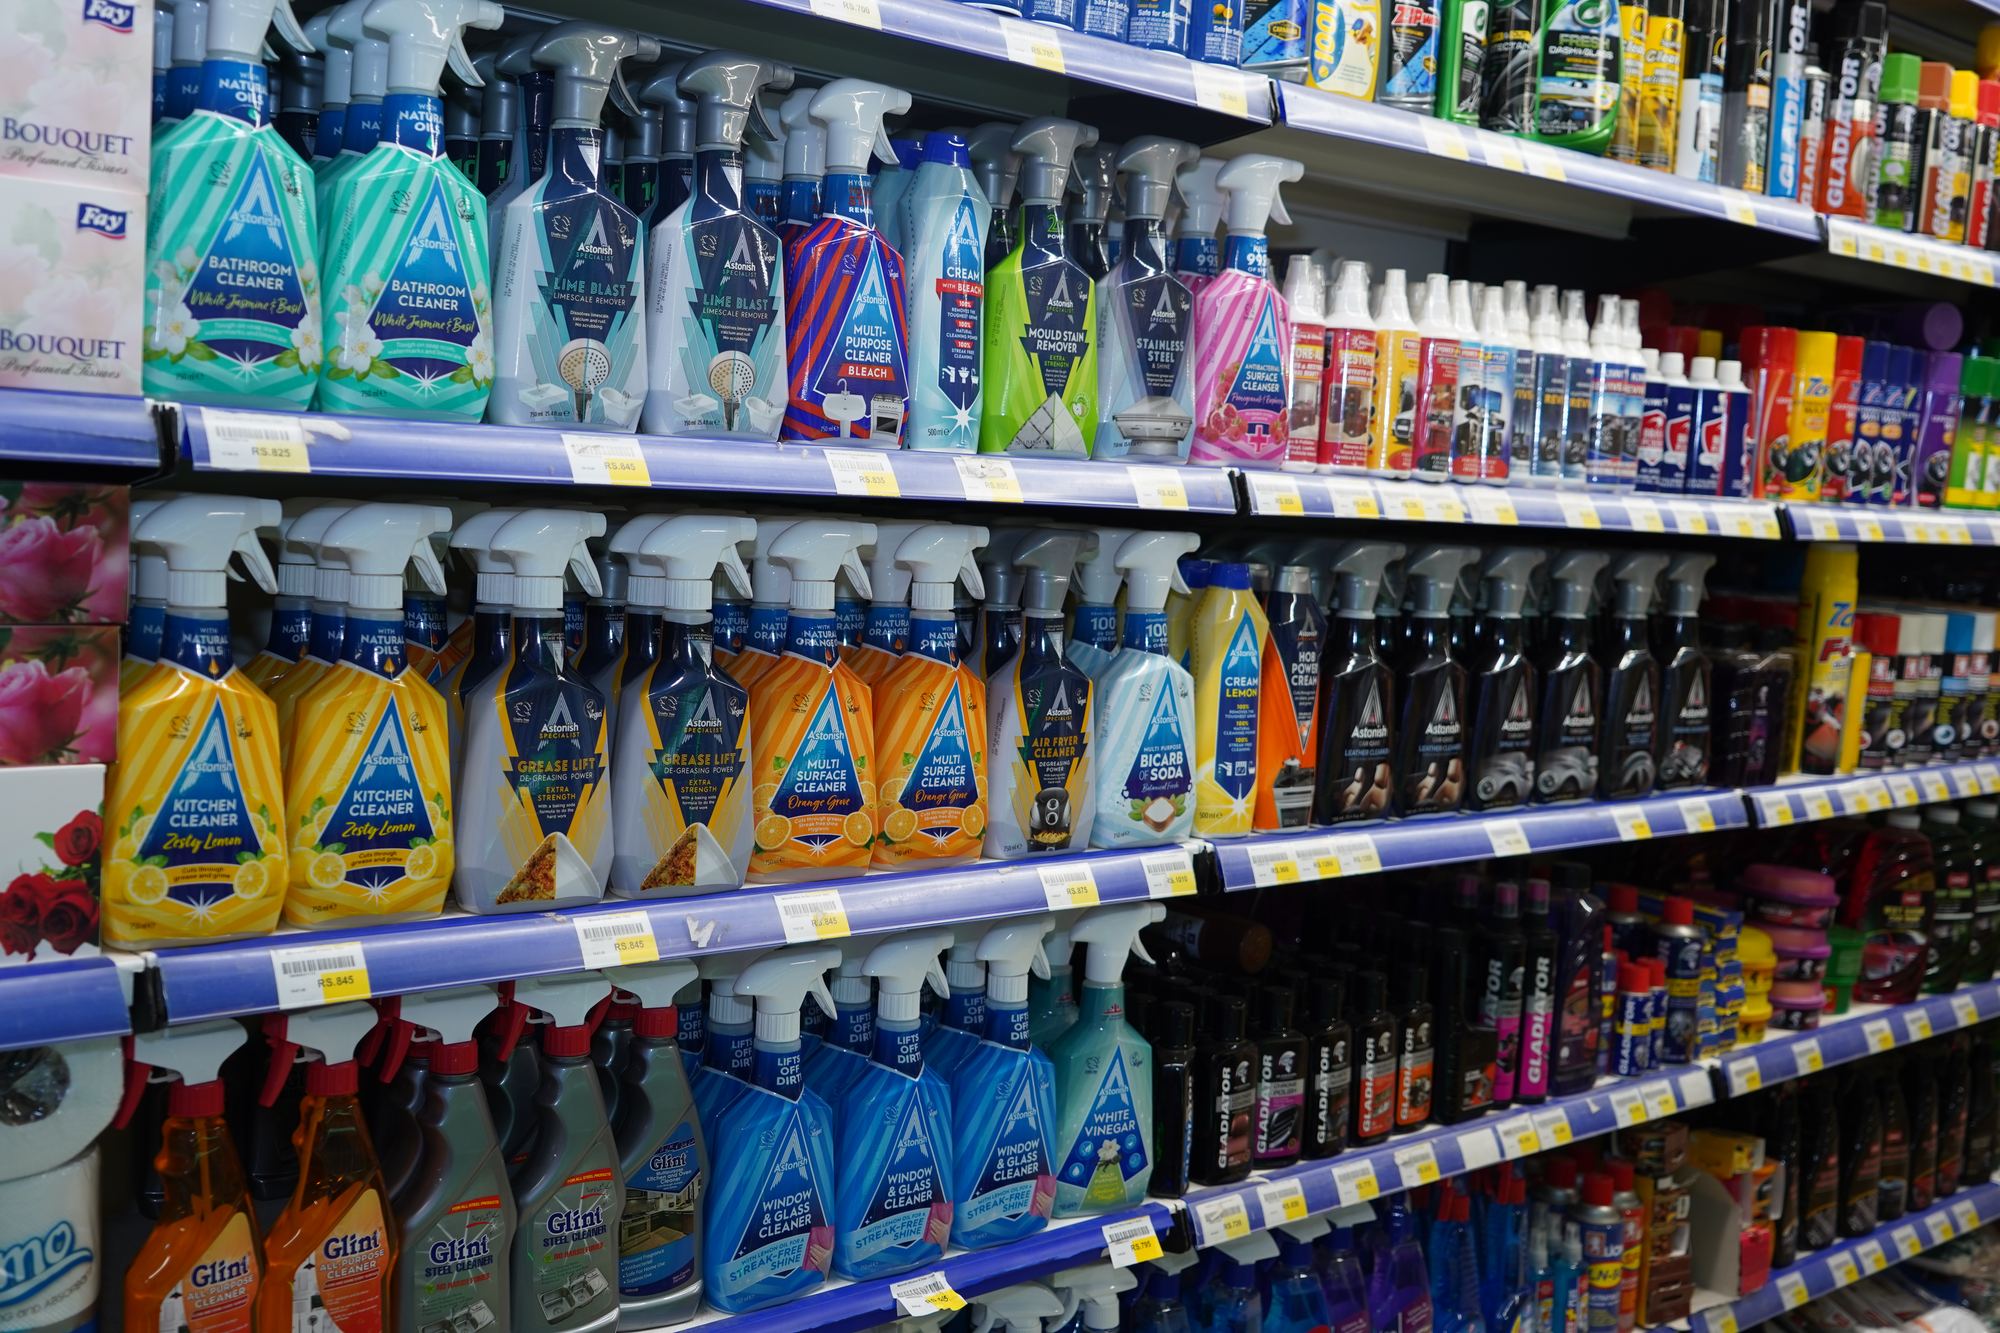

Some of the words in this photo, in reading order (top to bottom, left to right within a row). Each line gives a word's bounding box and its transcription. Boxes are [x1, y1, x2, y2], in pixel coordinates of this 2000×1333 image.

[1, 117, 133, 158] BOUQUET
[1826, 56, 1861, 208] GLADIATOR
[1, 146, 81, 170] Perfumed
[83, 156, 129, 175] Tissues
[410, 236, 456, 252] Astonish
[578, 242, 613, 255] Astonish
[209, 255, 292, 277] BATHROOM
[724, 260, 756, 272] Astonish
[947, 267, 979, 281] CREAM
[216, 272, 285, 291] CLEANER
[553, 277, 584, 294] LIME
[590, 282, 625, 297] BLAST
[392, 280, 466, 299] BATHROOM
[957, 283, 981, 295] BLEACH
[398, 296, 458, 311] CLEANER
[553, 292, 593, 303] LIMESCALE
[596, 297, 625, 306] REMOVER
[703, 294, 732, 308] LIME
[737, 298, 768, 310] BLAST
[857, 295, 887, 305] Astonish
[703, 307, 739, 317] LIMESCALE
[741, 311, 768, 320] REMOVER
[1029, 328, 1062, 341] MOULD
[1064, 330, 1084, 342] STAIN
[846, 336, 892, 351] PURPOSE
[1037, 340, 1077, 353] REMOVER
[1137, 338, 1184, 351] STAINLESS
[845, 350, 891, 363] CLEANER
[1148, 351, 1174, 363] STEEL
[1, 356, 71, 378] Perfumed
[72, 361, 121, 379] Tissues
[848, 365, 887, 378] BLEACH
[1246, 371, 1278, 382] SURFACE
[1242, 381, 1279, 393] CLEANSER
[251, 445, 291, 458] RS.825
[1299, 651, 1316, 662] HOB
[1225, 676, 1258, 686] CREAM
[1226, 688, 1257, 697] LEMON
[541, 723, 578, 733] Astonish
[686, 718, 722, 728] Astonish
[808, 730, 844, 741] Astonish
[934, 728, 964, 738] Astonish
[1352, 725, 1388, 738] Astonish
[1032, 738, 1050, 747] AIR
[1053, 736, 1078, 746] FRYER
[662, 753, 711, 766] GREASE
[714, 752, 736, 765] LIFT
[1034, 747, 1075, 758] CLEANER
[1140, 752, 1183, 767] BICARB
[186, 761, 234, 773] Astonish
[364, 754, 409, 766] Astonish
[518, 759, 568, 772] GREASE
[572, 758, 595, 771] LIFT
[807, 759, 839, 769] MULTI
[933, 755, 960, 765] MULTI
[796, 770, 846, 782] SURFACE
[923, 765, 966, 776] SURFACE
[1139, 769, 1150, 780] OF
[1151, 766, 1183, 780] SODA
[795, 781, 846, 793] CLEANER
[921, 776, 966, 788] CLEANER
[353, 789, 413, 802] KITCHEN
[537, 793, 576, 801] STRENGTH
[173, 799, 237, 812] KITCHEN
[349, 803, 414, 816] CLEANER
[169, 813, 238, 828] CLEANER
[342, 821, 378, 840] Zesty
[379, 820, 416, 836] Lemon
[162, 832, 201, 853] Zesty
[203, 832, 242, 850] Lemon
[1067, 886, 1088, 896] RS.875
[614, 940, 644, 953] RS.845
[317, 975, 354, 989] RS.845
[1528, 957, 1550, 1083] GLADIATOR
[897, 1034, 919, 1045] LIFTS
[900, 1043, 918, 1055] OFF
[777, 1055, 800, 1067] LIFTS
[780, 1065, 799, 1077] OFF
[1400, 1028, 1414, 1120] GLADIATOR
[777, 1074, 801, 1087] DIRT
[1363, 1037, 1376, 1132] GLADIATOR
[1317, 1046, 1330, 1144] GLADIATOR
[1257, 1055, 1273, 1153] GLADIATOR
[1094, 1109, 1129, 1123] WHITE
[1219, 1067, 1232, 1168] GLADIATOR
[1085, 1120, 1135, 1137] VINEGAR
[898, 1135, 927, 1148] Astonish
[997, 1139, 1039, 1156] WINDOW
[651, 1152, 685, 1171] Glint
[774, 1158, 807, 1172] Astonish
[997, 1158, 1004, 1169] &
[1007, 1152, 1038, 1167] GLASS
[646, 1173, 666, 1183] Kitchen
[668, 1172, 678, 1180] and
[888, 1166, 933, 1184] WINDOW
[994, 1163, 1039, 1182] CLEANER
[660, 1176, 681, 1185] Cleaner
[888, 1186, 896, 1197] &
[899, 1179, 931, 1196] GLASS
[763, 1189, 812, 1212] WINDOW
[885, 1190, 932, 1210] CLEANER
[547, 1206, 603, 1235] Glint
[763, 1213, 771, 1225] &
[774, 1202, 810, 1221] GLASS
[759, 1214, 811, 1239] CLEANER
[894, 1226, 922, 1241] SHINE
[543, 1234, 569, 1248] STEEL
[572, 1225, 606, 1243] CLEANER
[323, 1230, 380, 1260] Glint
[430, 1235, 489, 1264] Glint
[327, 1260, 377, 1279] CLEANER
[425, 1262, 453, 1278] STEEL
[455, 1255, 493, 1273] CLEANER
[730, 1244, 802, 1282] STREAK-FREE
[771, 1254, 801, 1271] SHINE
[192, 1257, 248, 1287] Glint
[195, 1288, 247, 1308] CLEANER
